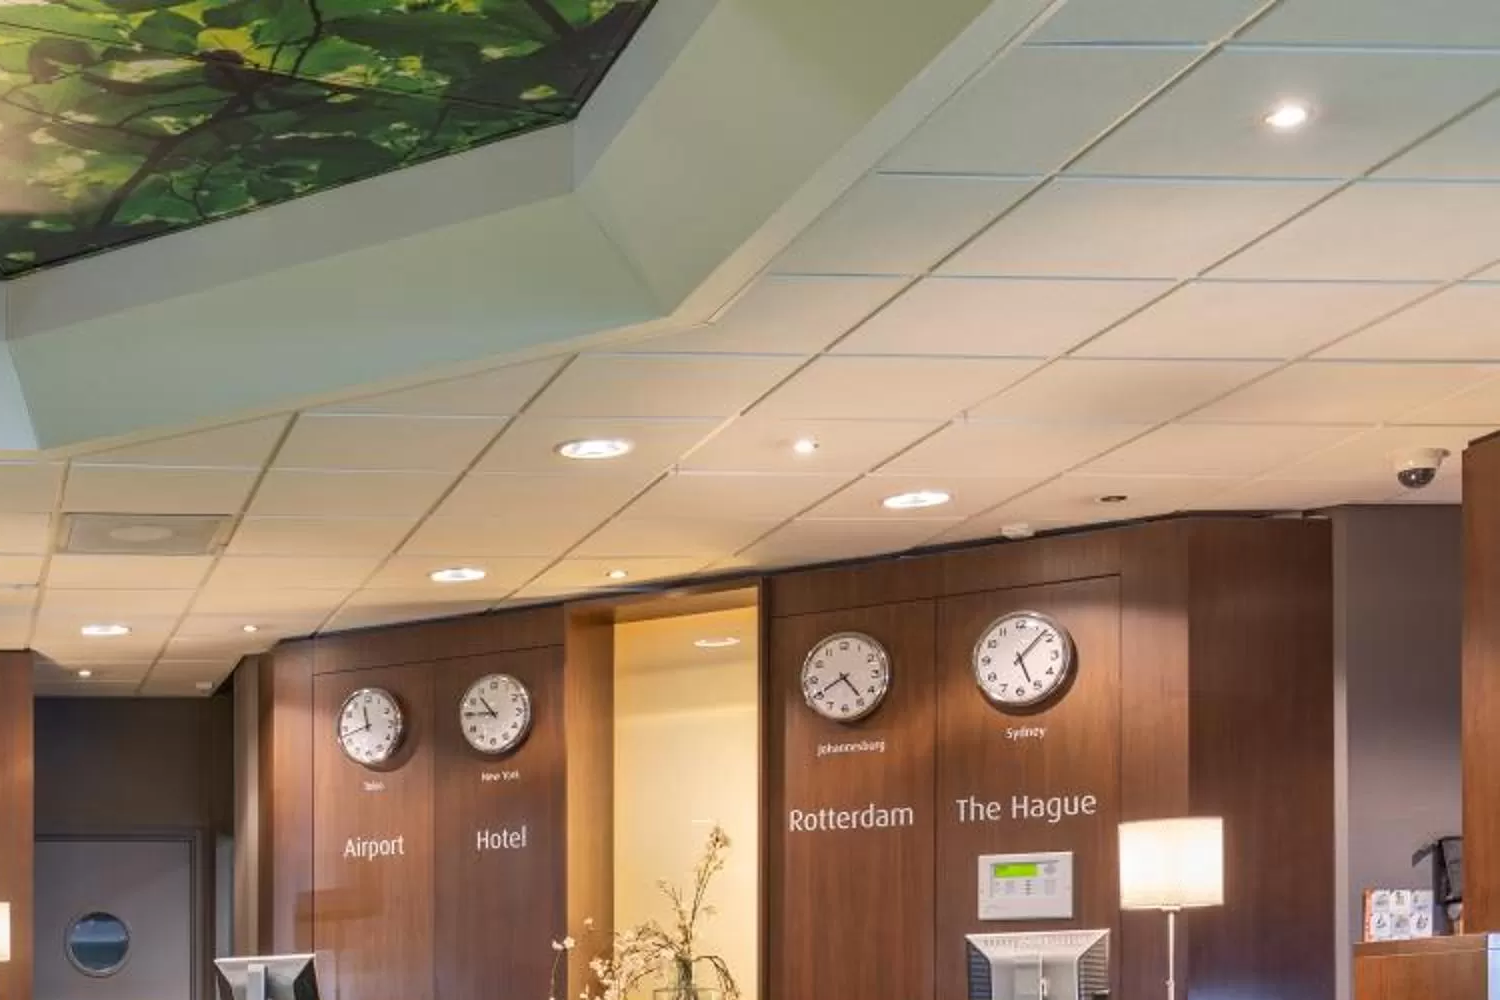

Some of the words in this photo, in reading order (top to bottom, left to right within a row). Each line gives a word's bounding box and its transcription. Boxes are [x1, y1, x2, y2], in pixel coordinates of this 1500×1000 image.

[1005, 726, 1046, 740] Sydney
[789, 804, 914, 832] Rotterdam
[956, 797, 1001, 822] The
[1011, 794, 1097, 823] Hague
[343, 835, 405, 861] Airport
[476, 826, 527, 851] Hotel
